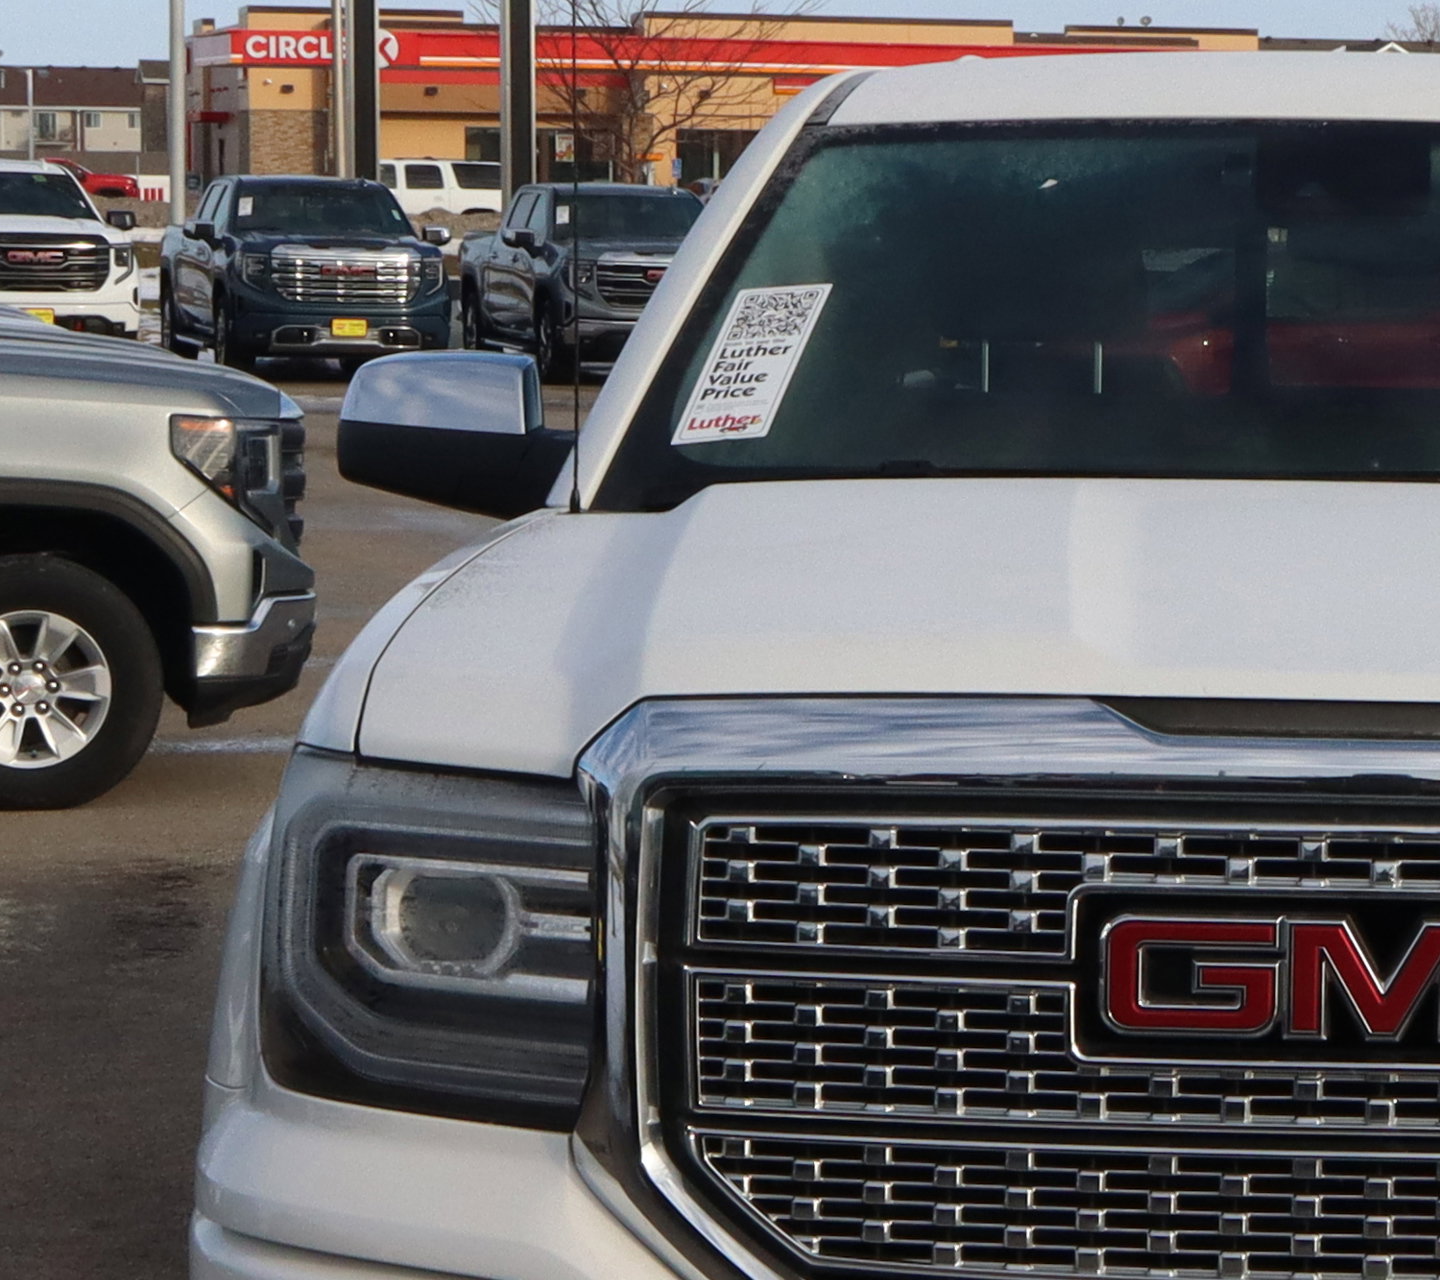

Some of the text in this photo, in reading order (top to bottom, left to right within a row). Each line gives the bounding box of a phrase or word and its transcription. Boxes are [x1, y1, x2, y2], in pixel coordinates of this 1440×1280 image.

[718, 344, 793, 360] Luther
[712, 358, 754, 373] Fair
[709, 372, 769, 386] Value
[700, 386, 757, 401] Price
[687, 414, 761, 431] Luther
